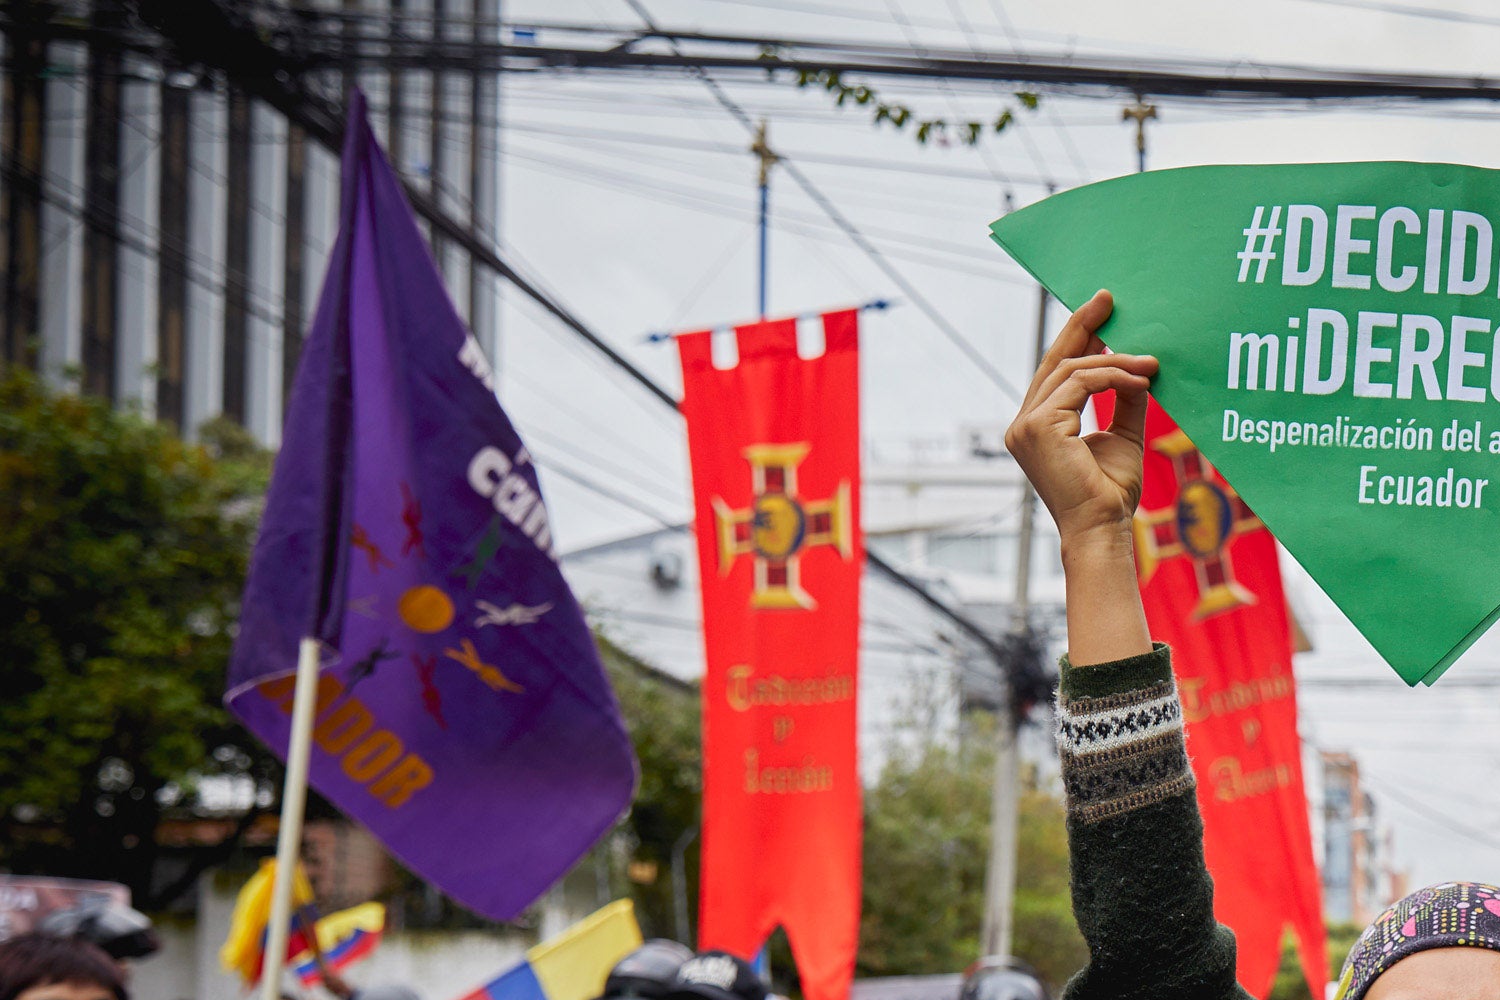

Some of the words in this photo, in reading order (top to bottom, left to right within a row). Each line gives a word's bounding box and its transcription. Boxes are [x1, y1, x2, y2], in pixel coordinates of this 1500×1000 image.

[1222, 409, 1433, 453] Despenalización
[1441, 419, 1482, 453] del
[1358, 464, 1489, 509] Ecuador
